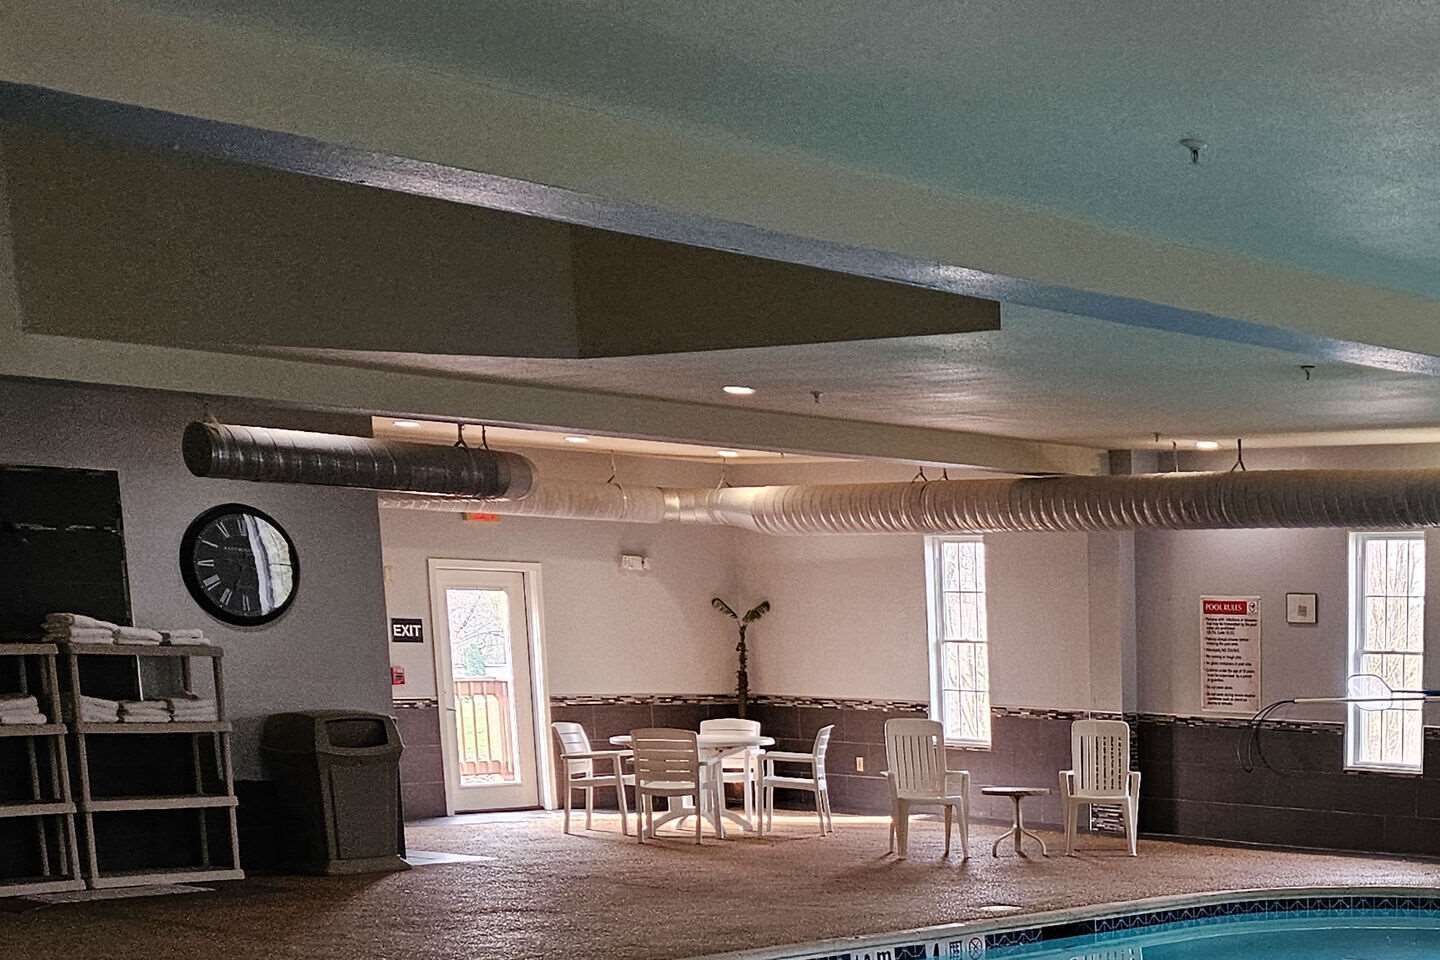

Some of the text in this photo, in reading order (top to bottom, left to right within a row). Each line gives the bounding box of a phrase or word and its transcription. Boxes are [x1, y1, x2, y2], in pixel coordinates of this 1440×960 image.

[1205, 602, 1243, 612] POOL RULES
[393, 624, 421, 637] EXIT
